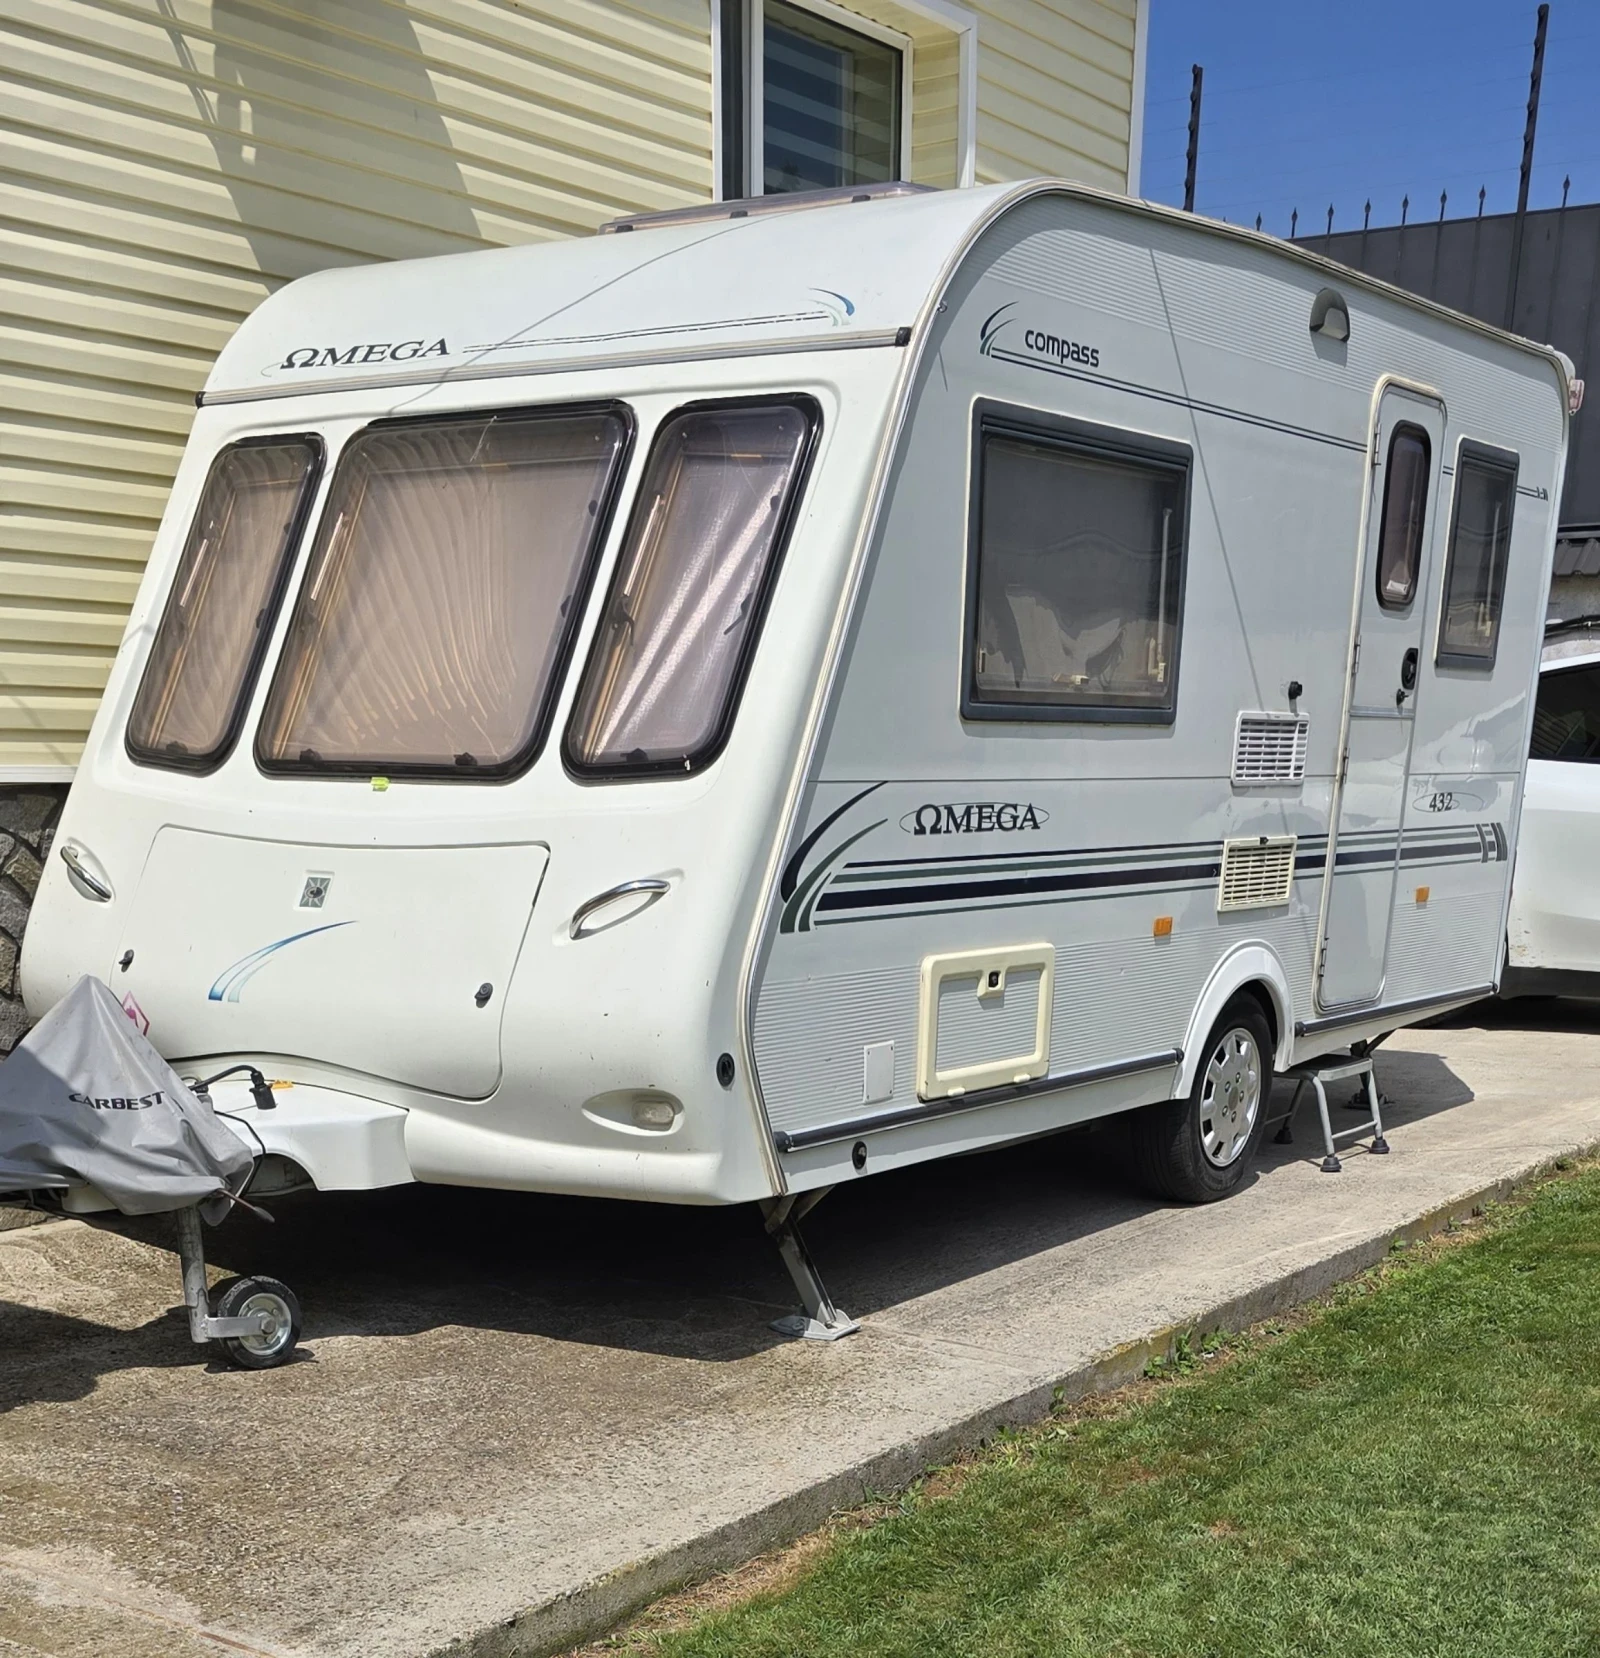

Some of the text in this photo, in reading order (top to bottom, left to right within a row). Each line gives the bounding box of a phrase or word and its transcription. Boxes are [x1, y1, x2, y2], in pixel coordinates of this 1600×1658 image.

[1025, 329, 1099, 368] compass
[1429, 792, 1453, 812] 432
[68, 1091, 165, 1110] CARBEST
